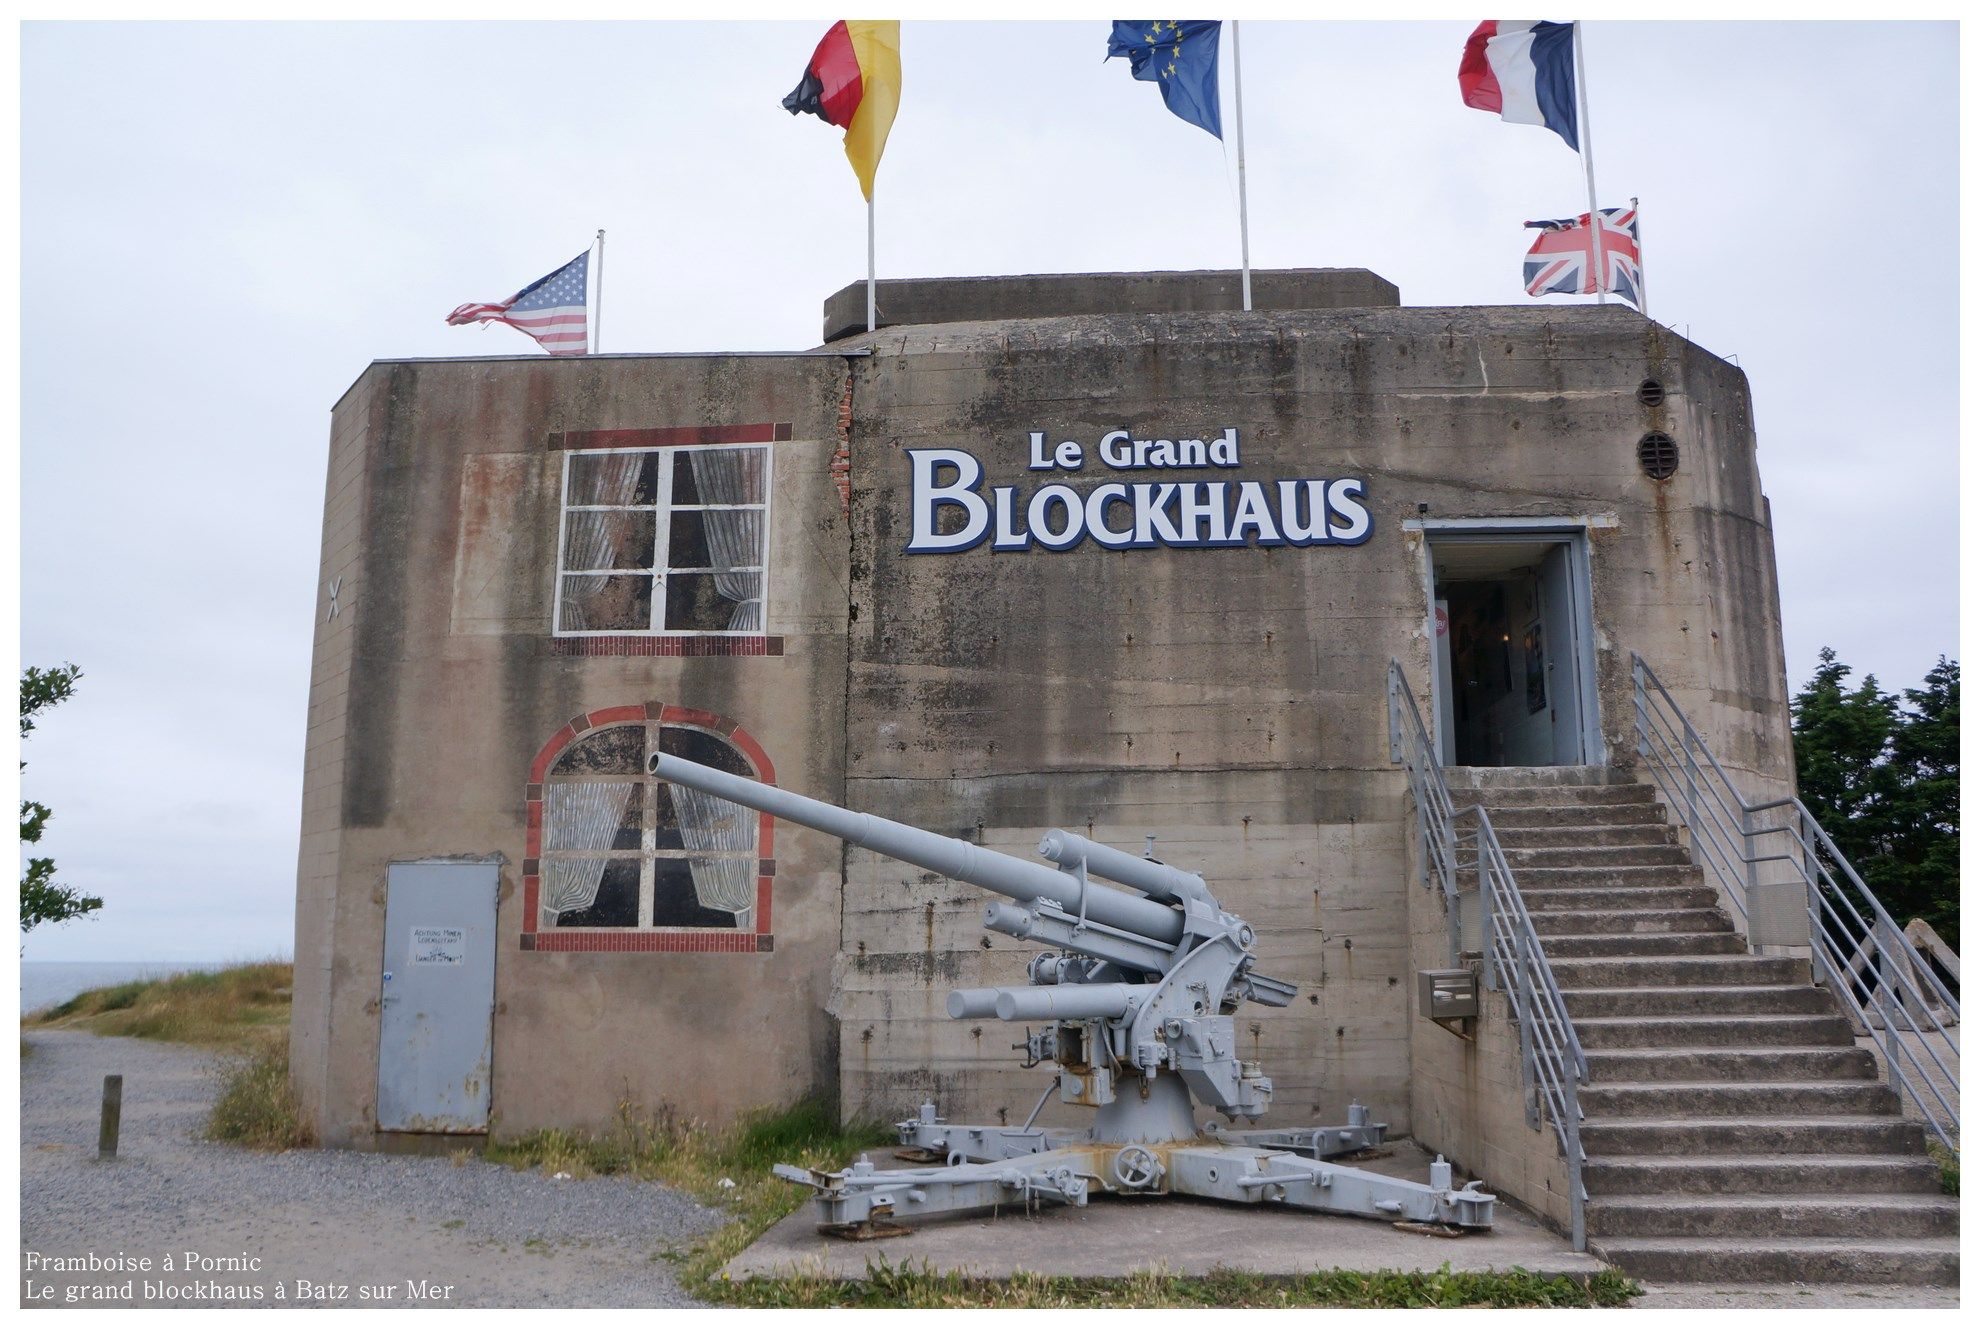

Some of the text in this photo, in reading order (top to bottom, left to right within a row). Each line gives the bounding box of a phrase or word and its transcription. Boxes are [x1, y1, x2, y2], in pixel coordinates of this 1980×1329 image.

[1028, 427, 1241, 470] Le Grand
[906, 447, 1373, 553] BLOCKHAUS
